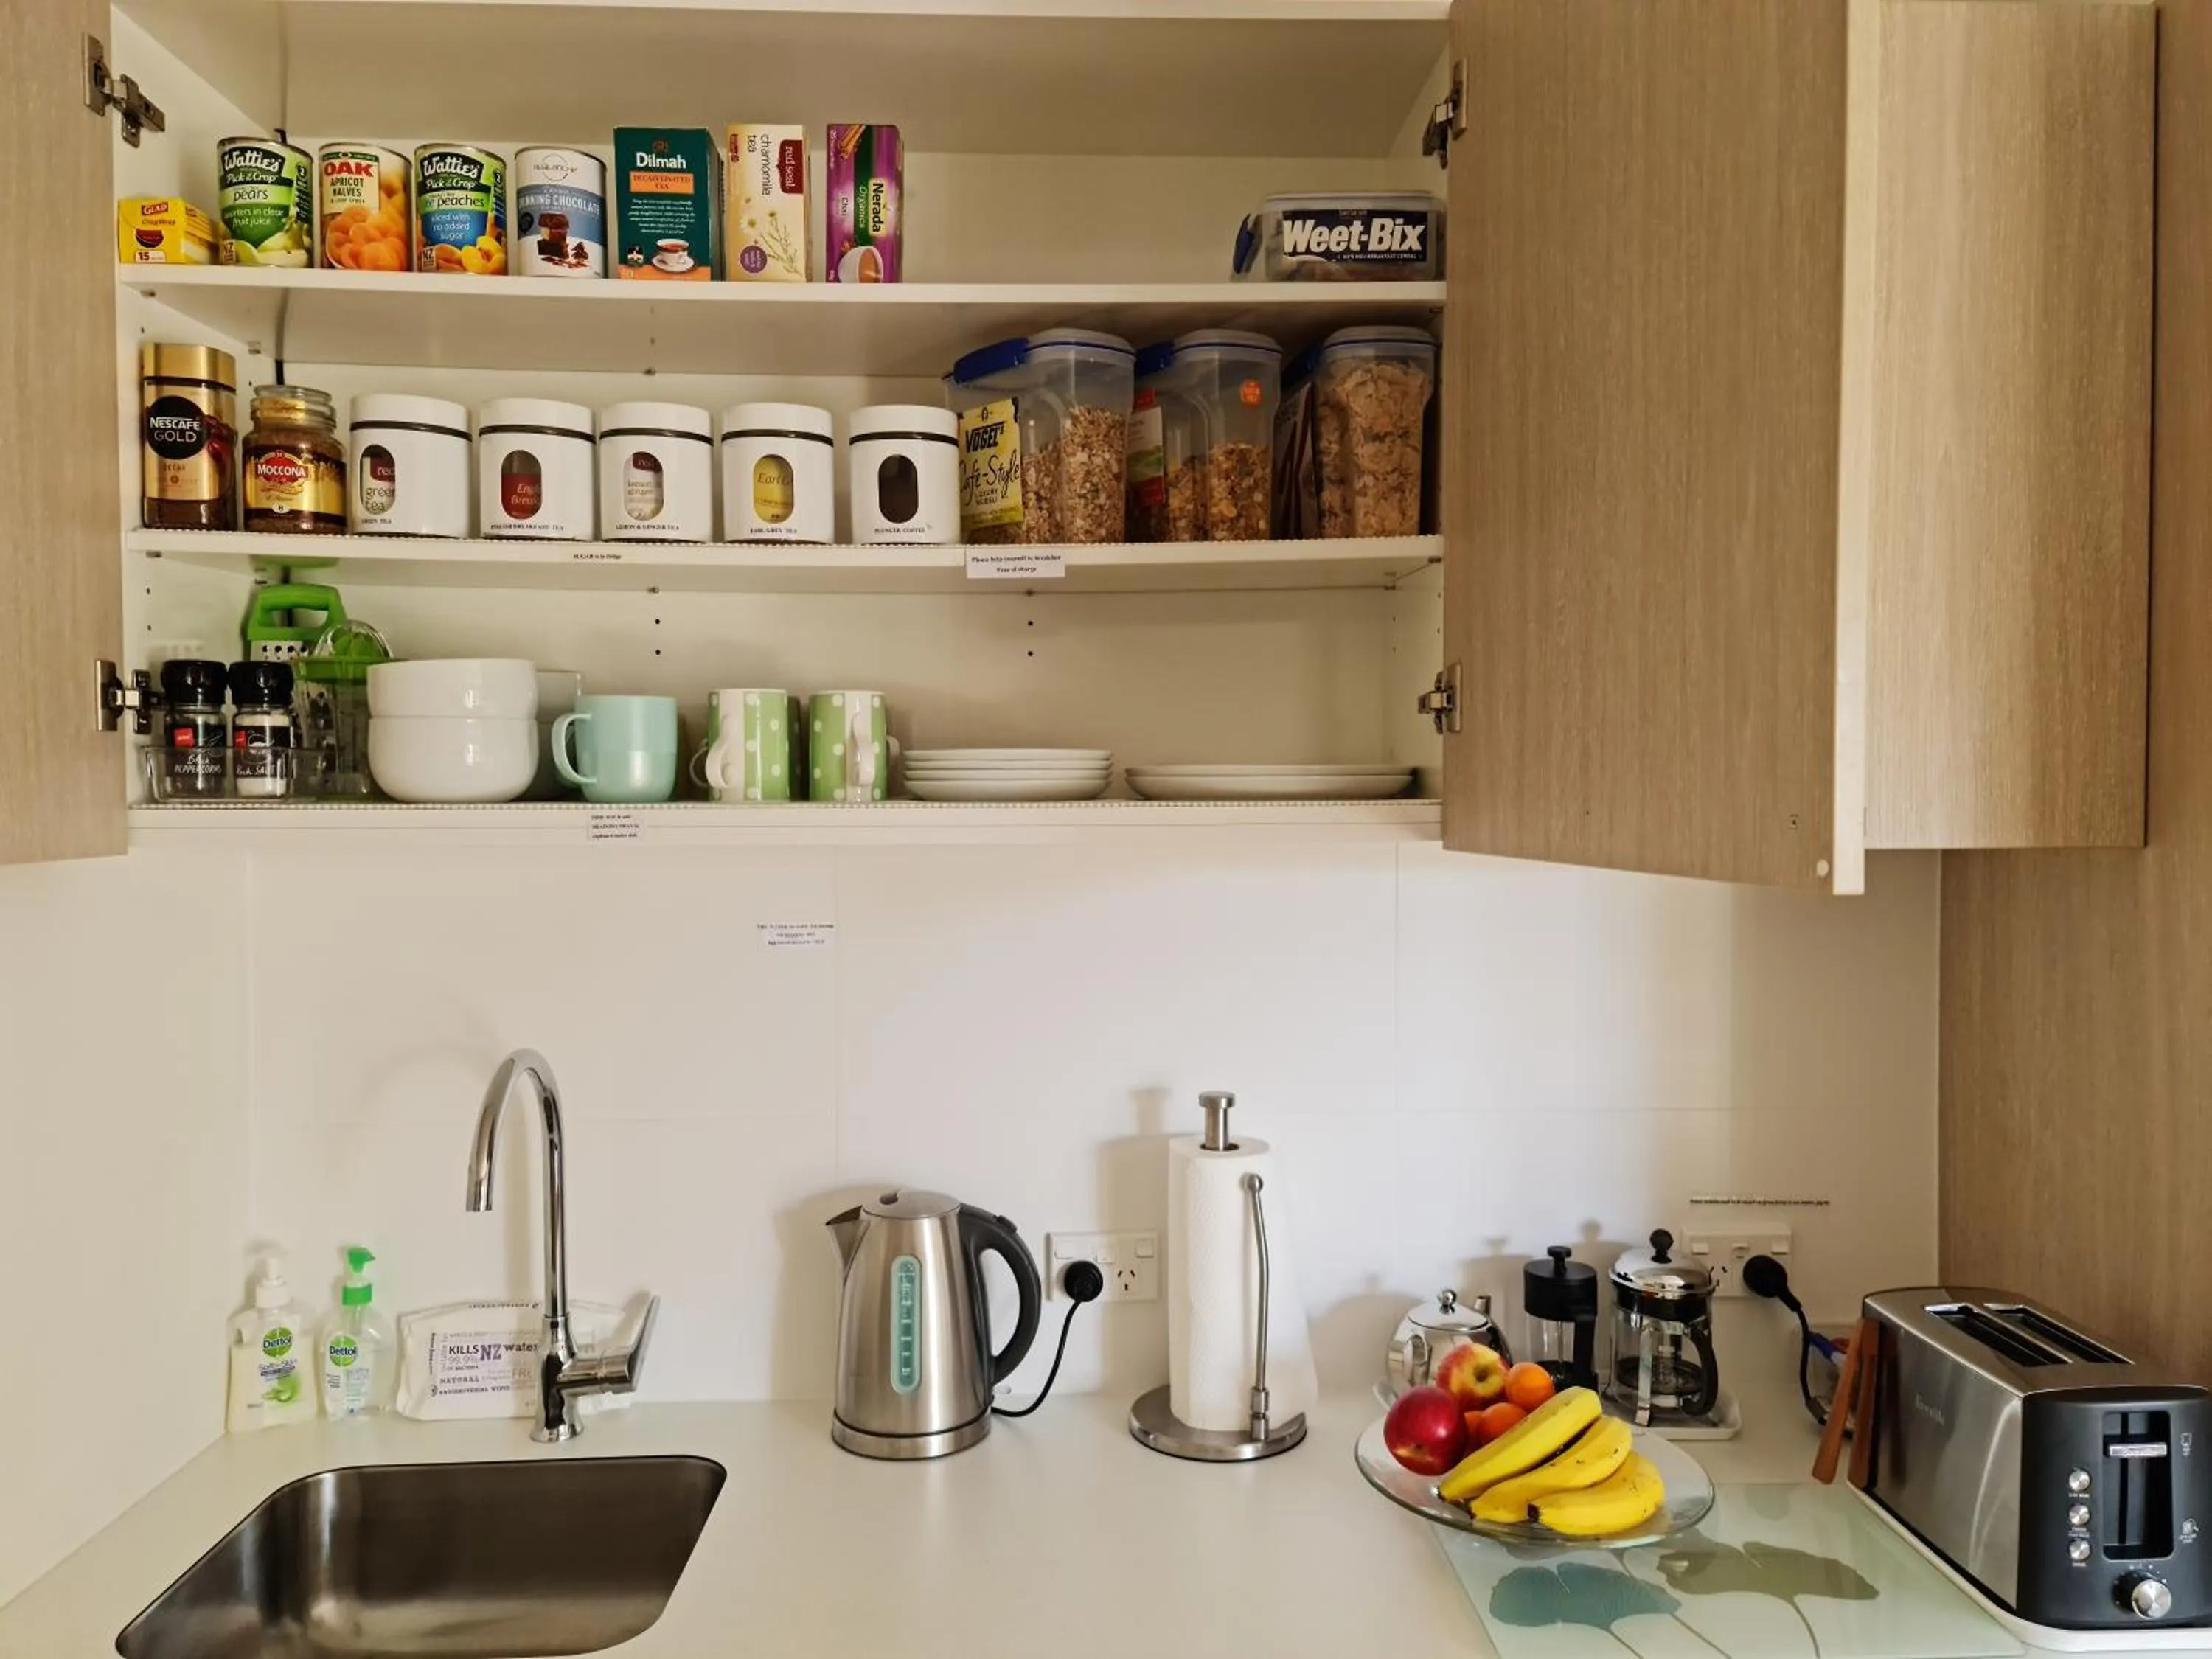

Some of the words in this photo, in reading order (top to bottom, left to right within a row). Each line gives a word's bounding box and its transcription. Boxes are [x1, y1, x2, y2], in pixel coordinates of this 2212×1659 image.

[747, 135, 758, 153] tea
[224, 150, 282, 172] Wattie's
[636, 152, 686, 169] Dilmah
[785, 146, 796, 164] red
[324, 161, 373, 177] OAK
[423, 156, 479, 178] Wattie's
[761, 134, 773, 195] chamomile
[253, 172, 277, 184] Crop
[330, 178, 364, 187] APRICOT
[785, 167, 796, 187] seal
[234, 189, 269, 203] pears
[333, 187, 362, 197] HALVES
[437, 194, 484, 208] peaches
[552, 195, 600, 215] CHOCOLATE
[857, 186, 868, 229] Organics
[872, 183, 884, 232] Nerada
[143, 203, 167, 215] GLAD
[1283, 218, 1426, 253] Weet-Bix
[138, 251, 150, 260] 15
[154, 430, 197, 442] GOLD
[257, 464, 306, 477] MOCCONA
[365, 501, 384, 512] tea
[263, 1336, 292, 1349] Dettol
[448, 1344, 479, 1354] KILLS
[330, 1346, 358, 1356] Dettol
[480, 1344, 502, 1361] NZ
[503, 1342, 538, 1352] water
